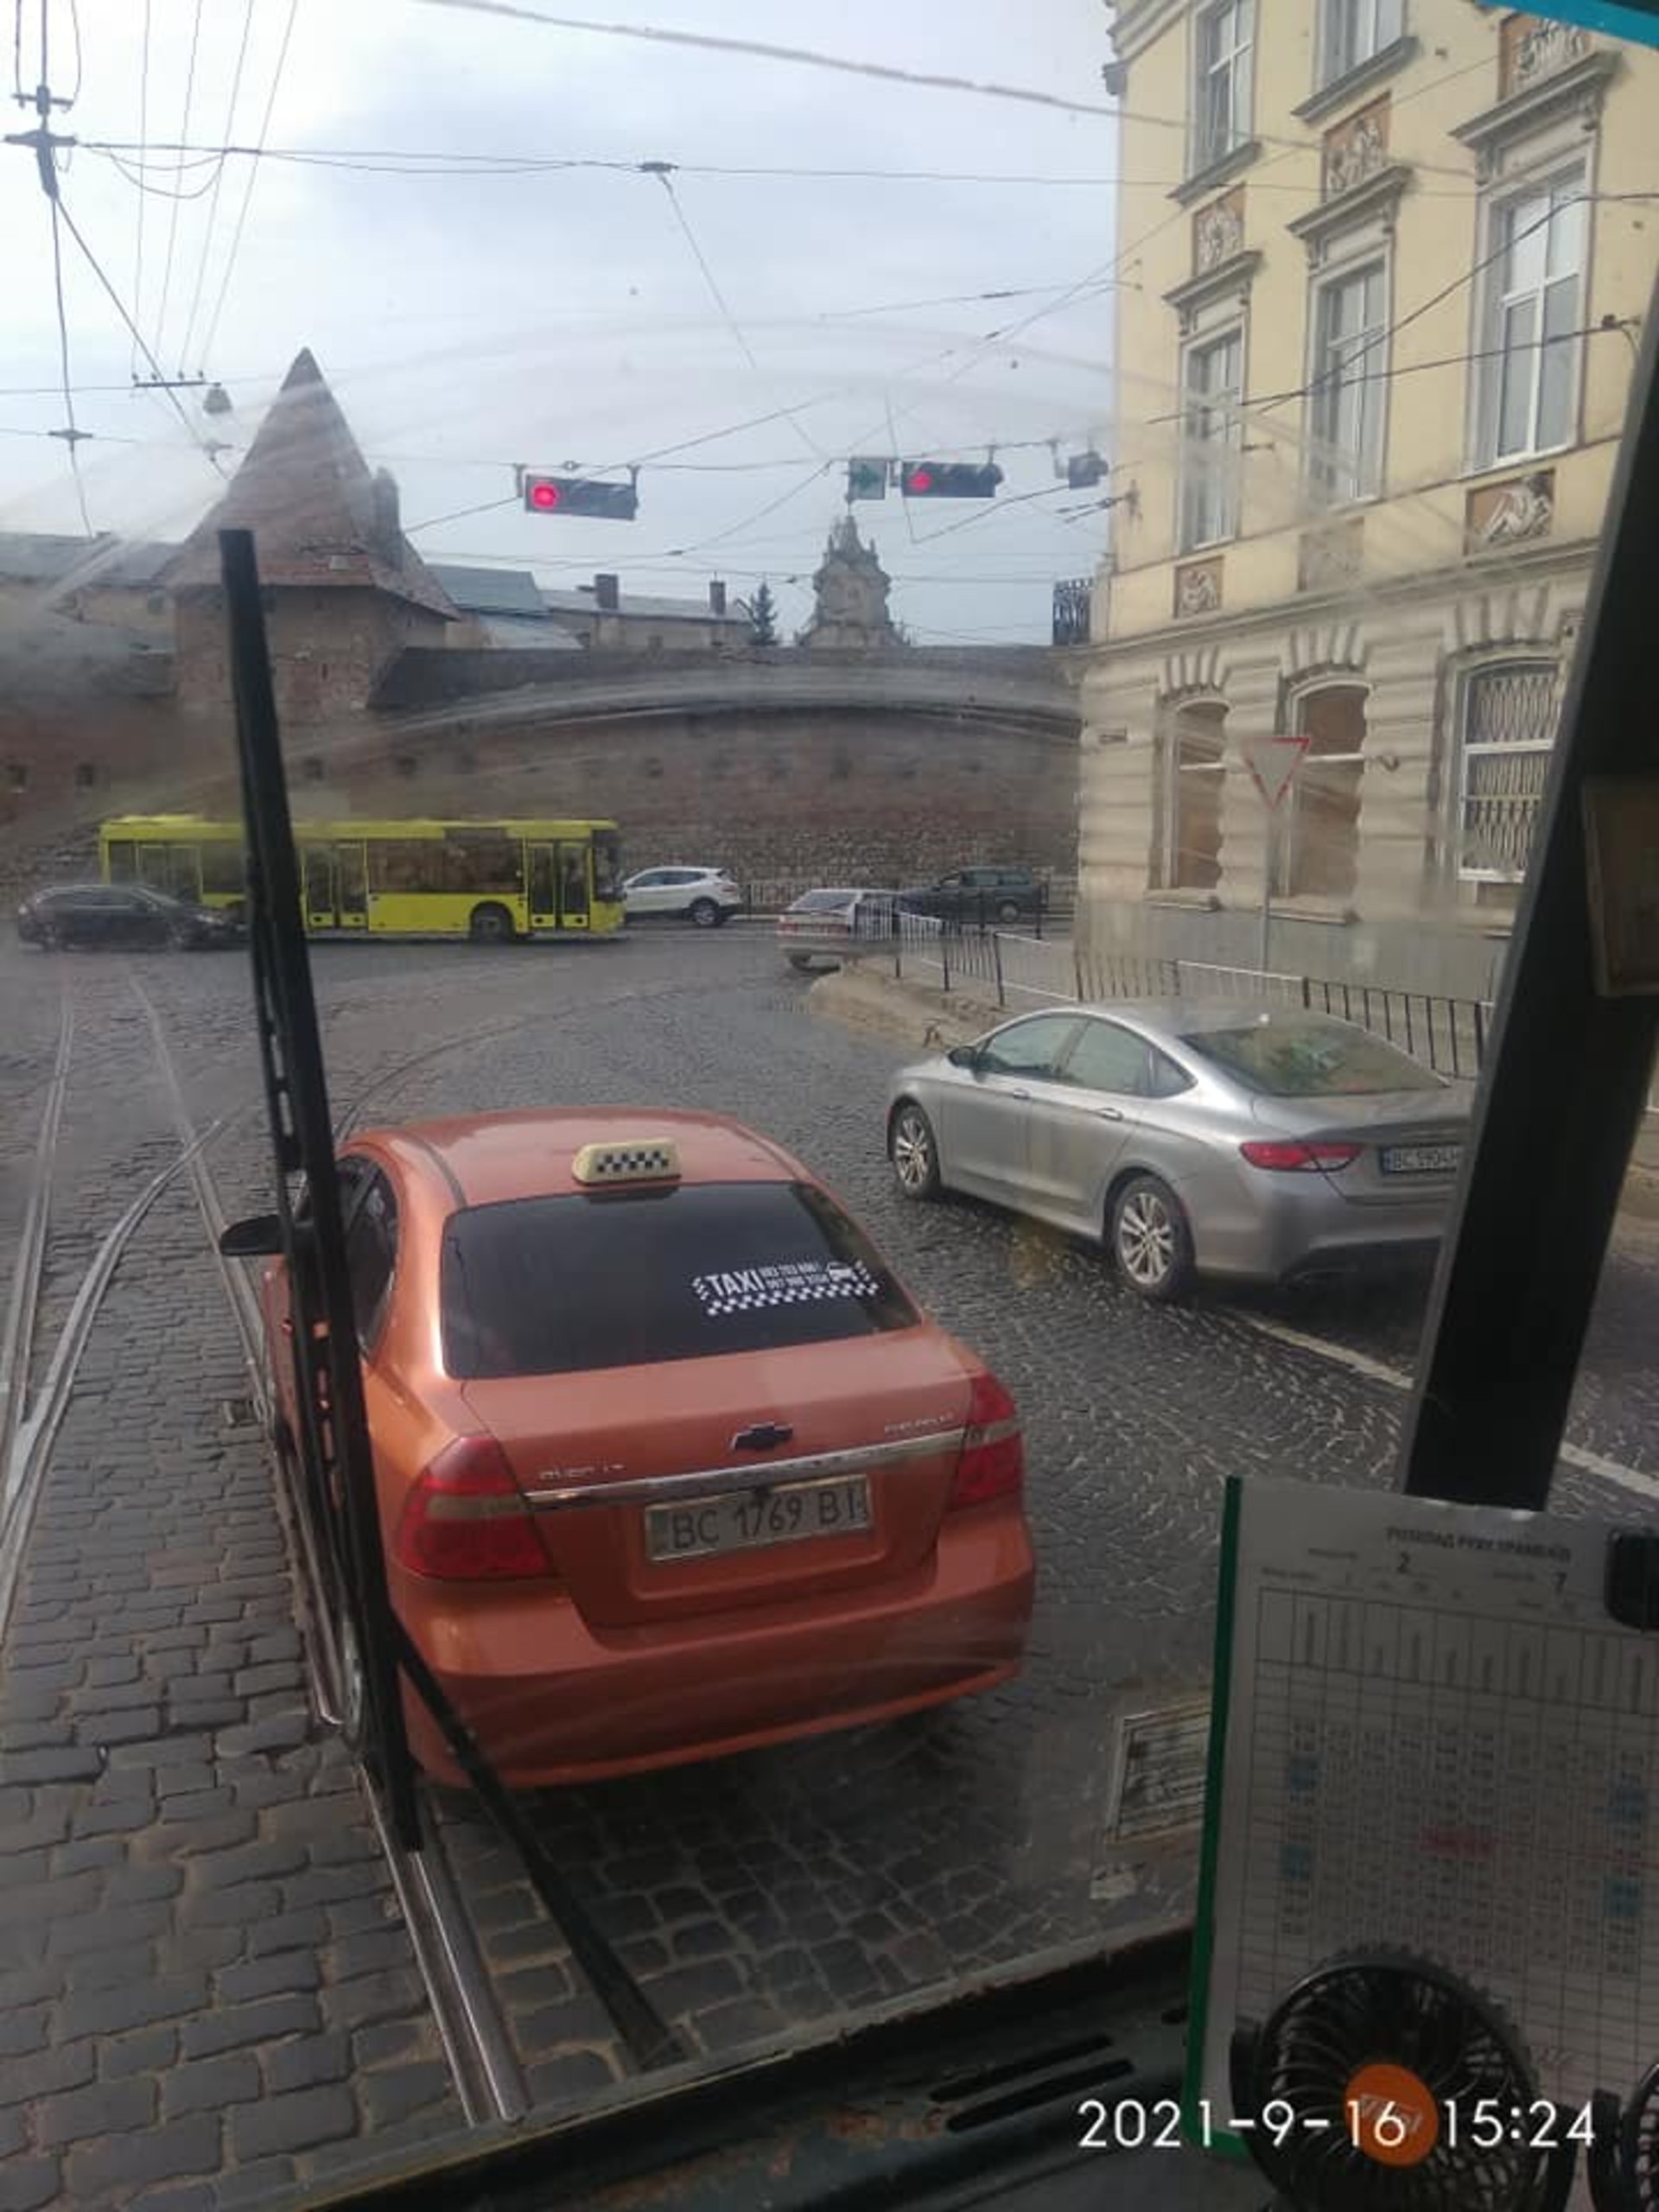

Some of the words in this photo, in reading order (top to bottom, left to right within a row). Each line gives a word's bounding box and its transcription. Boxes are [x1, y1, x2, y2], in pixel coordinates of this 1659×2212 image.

[705, 1269, 765, 1297] TAXI
[671, 1509, 720, 1548] BC
[734, 1494, 803, 1538] 1769
[1396, 1551, 1411, 1573] 2
